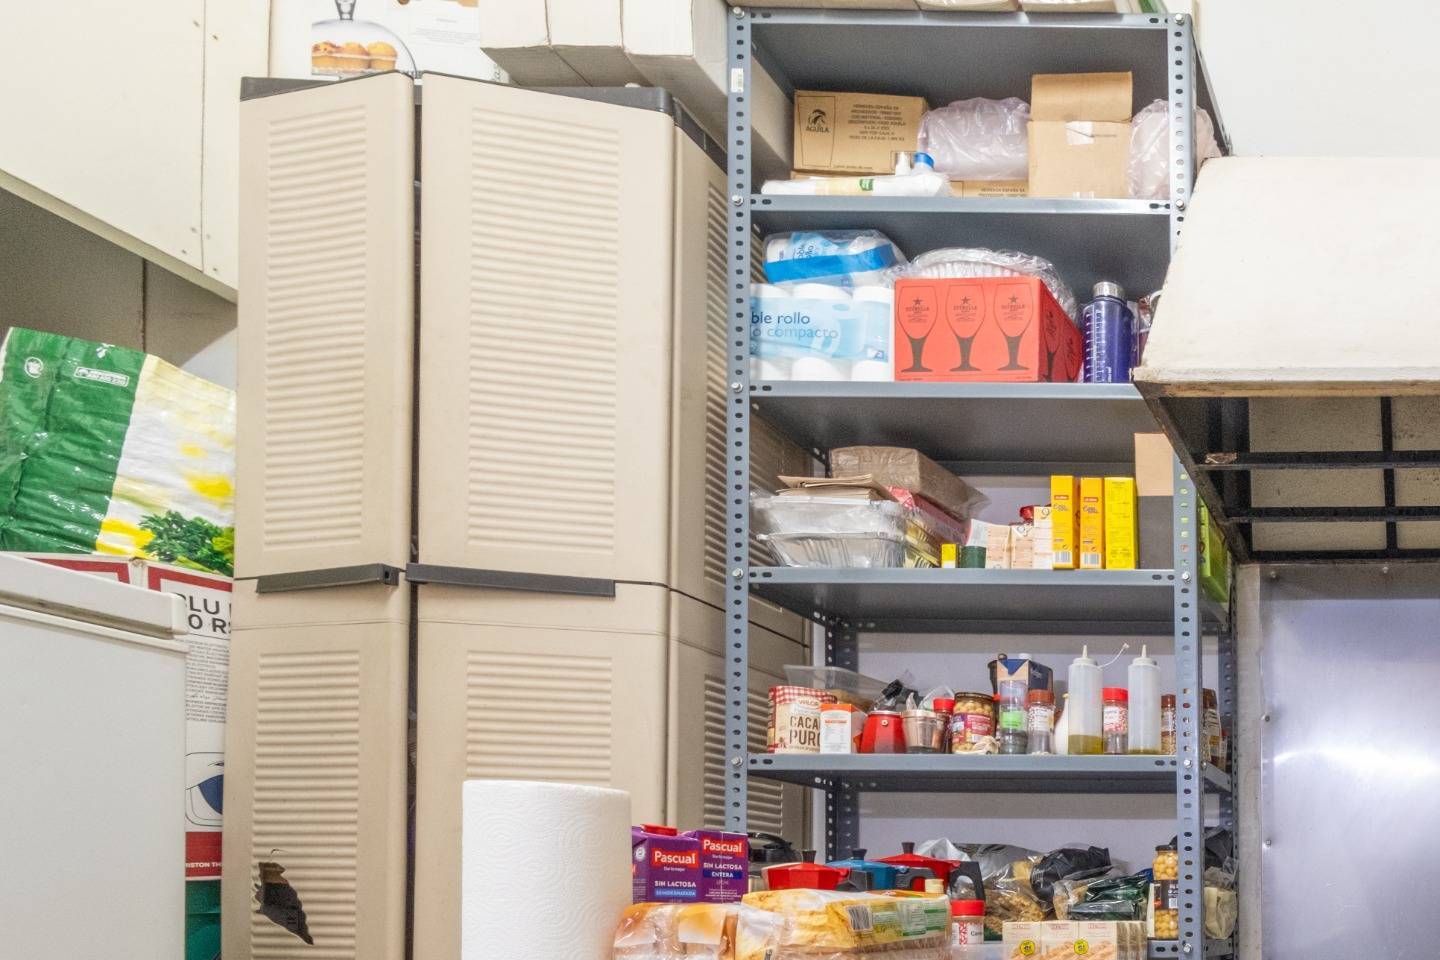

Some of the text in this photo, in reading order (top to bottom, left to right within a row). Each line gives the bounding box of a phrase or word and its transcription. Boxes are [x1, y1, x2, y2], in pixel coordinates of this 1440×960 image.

[777, 312, 811, 324] rollo
[767, 328, 839, 341] compacto
[790, 715, 820, 730] CACA
[703, 839, 742, 853] Pascual
[654, 850, 696, 864] Pascual
